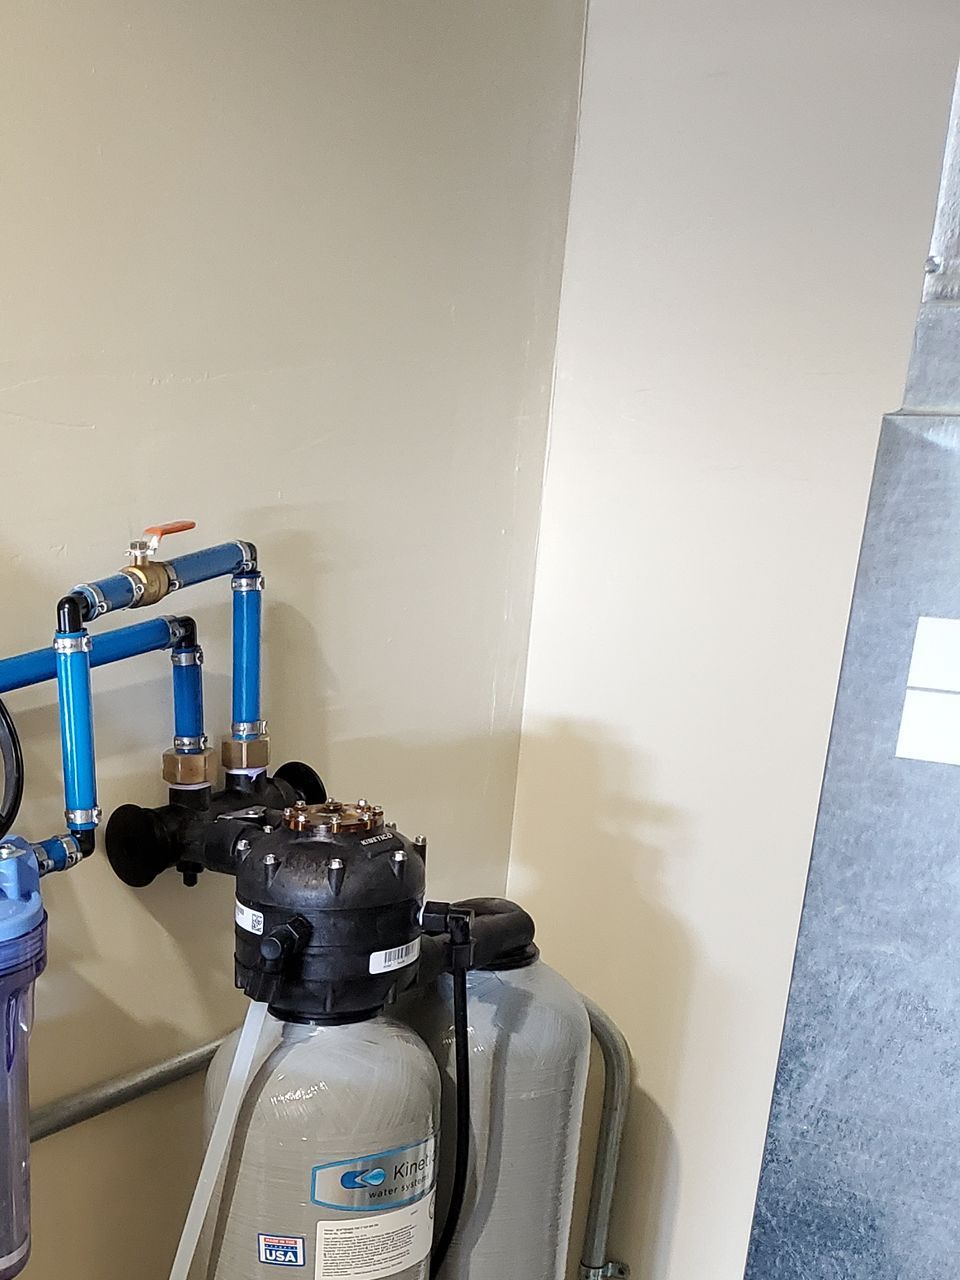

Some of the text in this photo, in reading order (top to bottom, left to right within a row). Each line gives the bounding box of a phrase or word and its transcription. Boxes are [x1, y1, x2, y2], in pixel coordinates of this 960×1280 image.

[360, 832, 394, 846] KINETICO
[368, 1186, 399, 1200] water
[266, 1249, 297, 1262] USA
